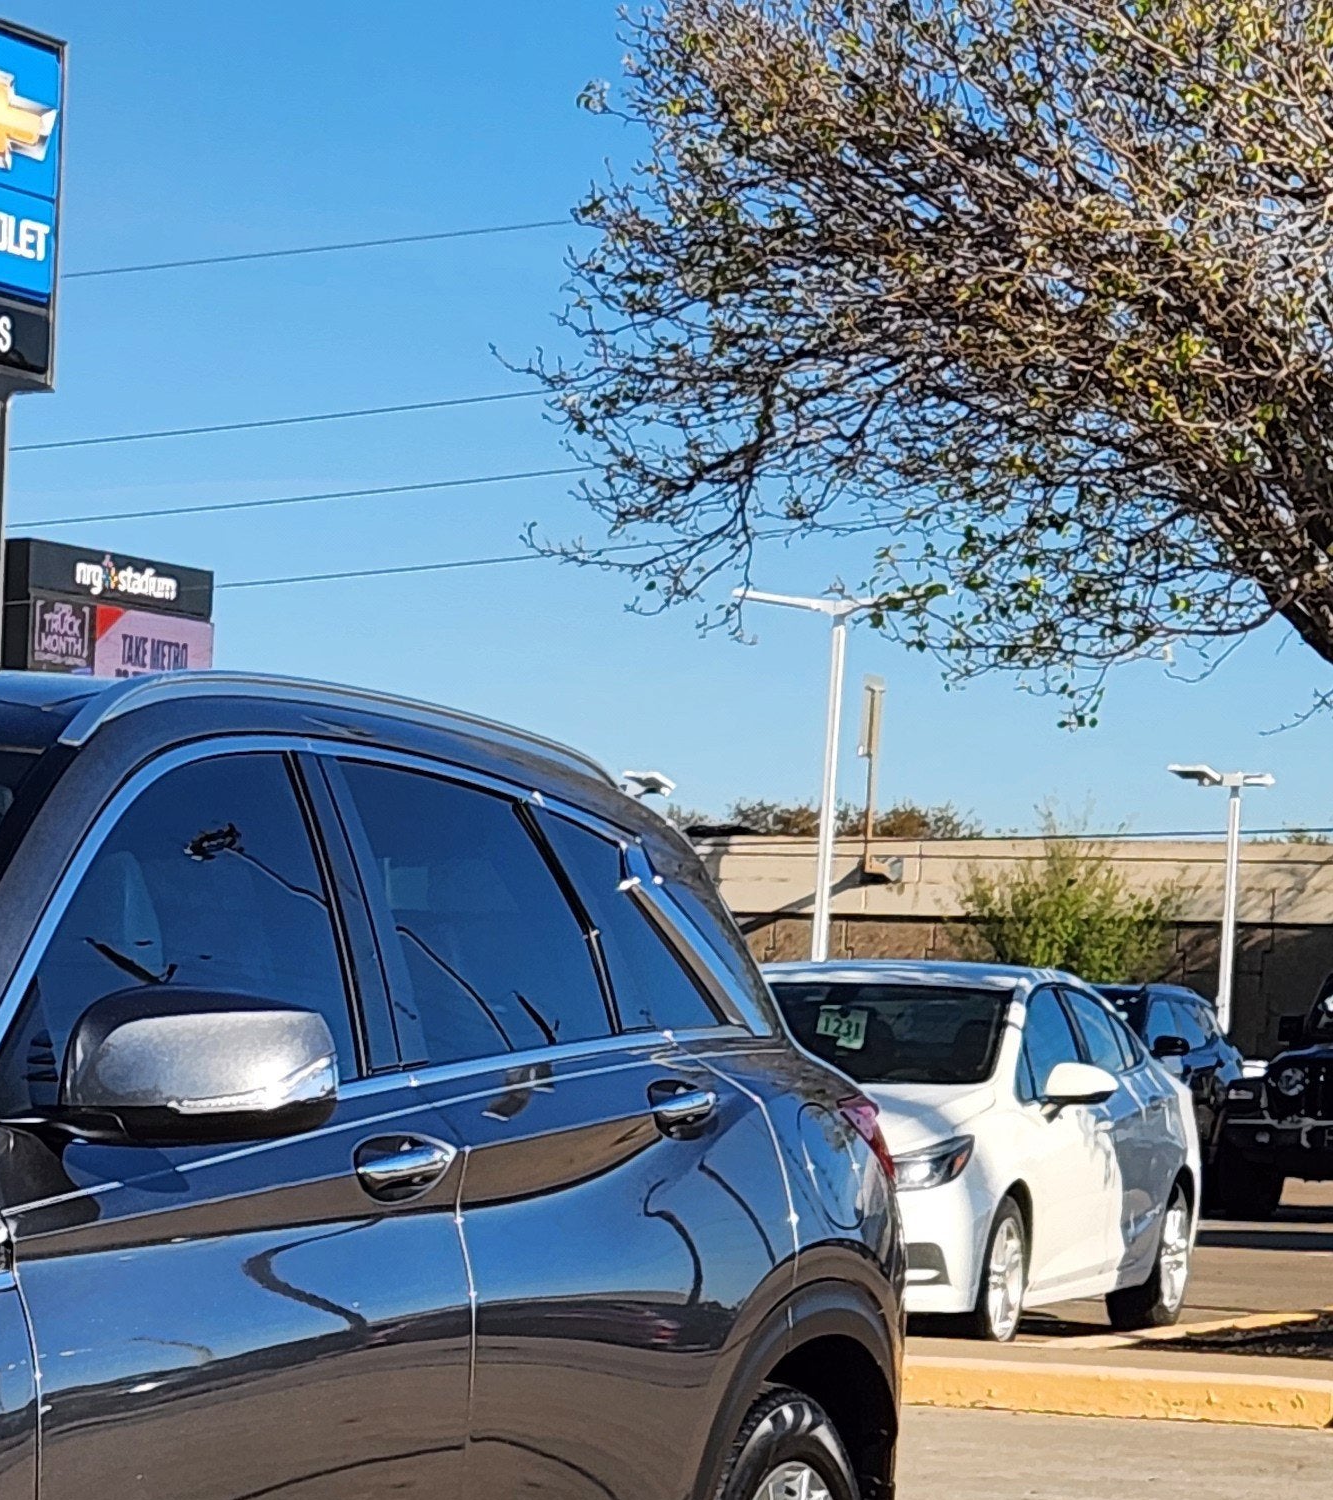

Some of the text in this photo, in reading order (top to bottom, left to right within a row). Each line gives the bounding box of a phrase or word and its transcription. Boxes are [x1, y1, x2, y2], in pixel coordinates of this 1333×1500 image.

[75, 562, 177, 600] nrg stadium
[43, 612, 81, 636] TRUCK
[41, 632, 82, 656] MONTH
[122, 633, 148, 668] TAKE
[824, 1016, 861, 1040] 1231
